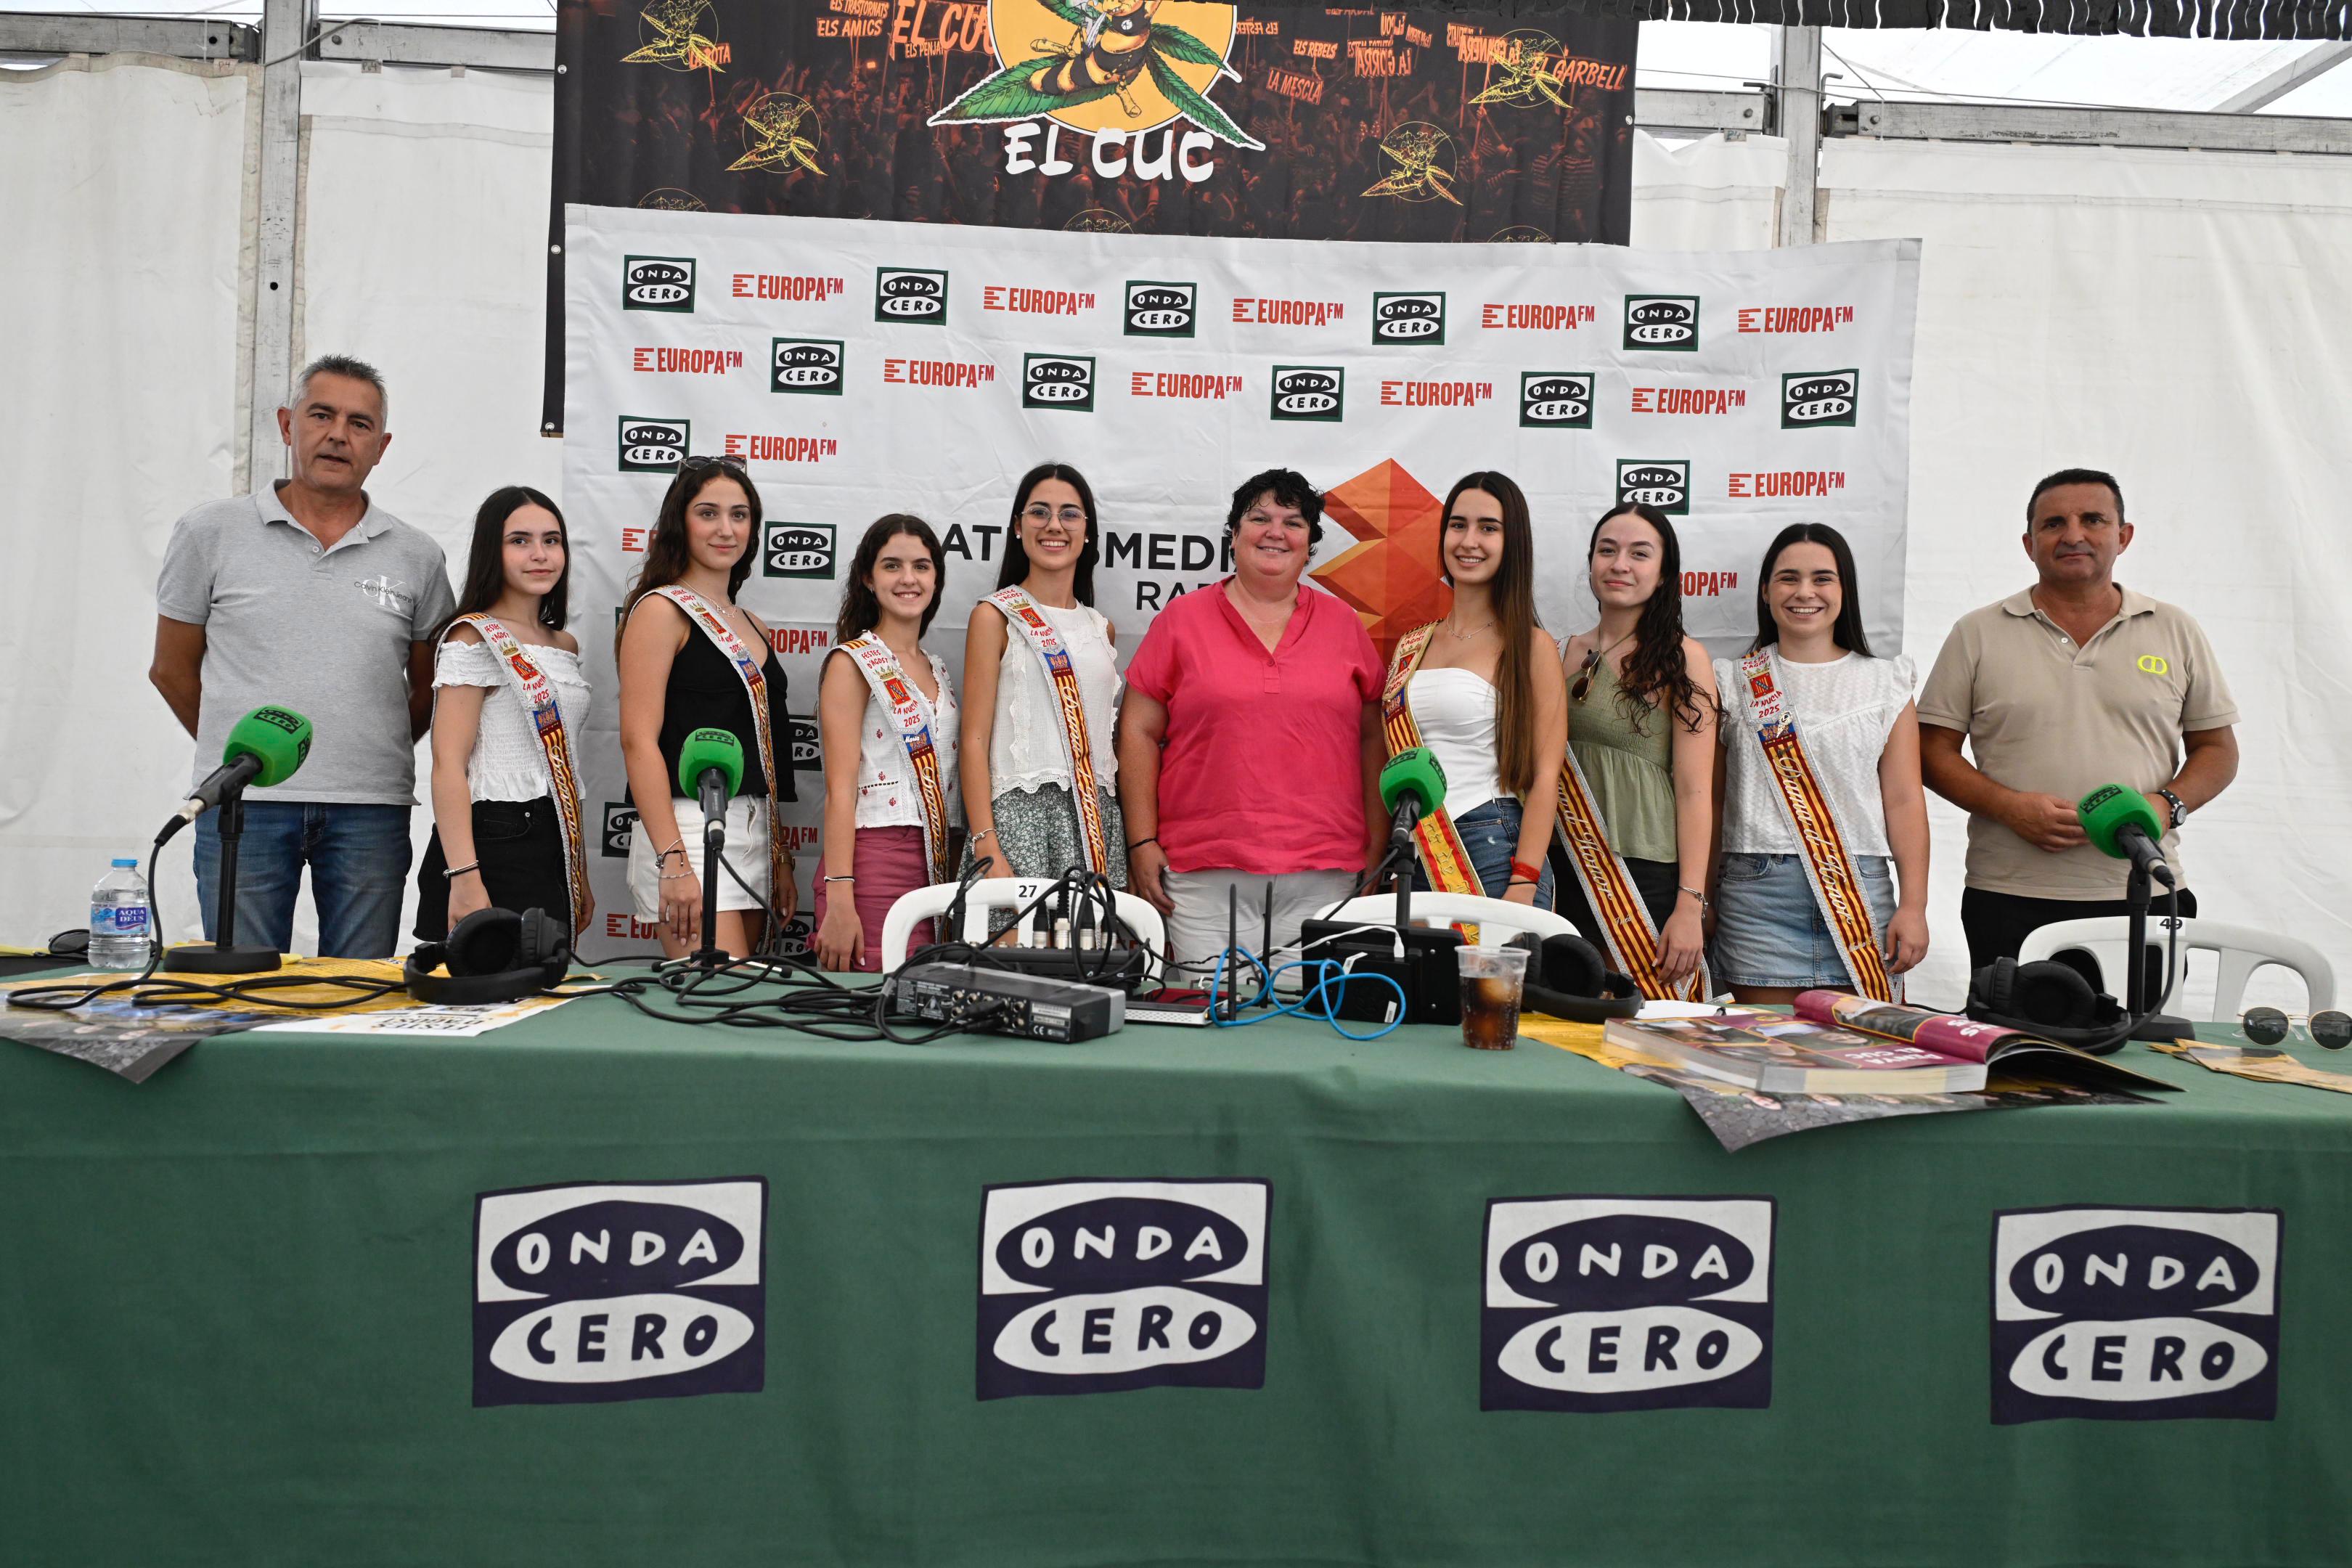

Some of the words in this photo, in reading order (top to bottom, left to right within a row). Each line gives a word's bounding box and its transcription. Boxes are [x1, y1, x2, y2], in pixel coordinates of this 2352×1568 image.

[817, 20, 838, 36] ELS
[841, 19, 883, 36] AMICS
[1294, 39, 1307, 56] ELS
[1307, 41, 1338, 59] REBELS
[1266, 69, 1280, 91] LA
[1280, 75, 1323, 105] MESCLA
[1004, 122, 1074, 177] EL
[1091, 126, 1214, 183] CUC
[636, 269, 682, 280] ONDA
[637, 287, 682, 299] CERO
[888, 281, 935, 293] ONDA
[890, 299, 934, 312] CERO
[1138, 293, 1183, 306] ONDA
[1385, 304, 1432, 316] ONDA
[1637, 309, 1685, 319] ONDA
[1138, 312, 1183, 324] CERO
[1387, 321, 1432, 333] CERO
[1638, 327, 1684, 339] CERO
[784, 351, 830, 362] ONDA
[785, 369, 830, 382] CERO
[1035, 366, 1081, 378] ONDA
[1284, 377, 1330, 389] ONDA
[1794, 382, 1845, 397] ONDA
[1037, 385, 1081, 398] CERO
[1533, 385, 1580, 396] ONDA
[1286, 396, 1330, 409] CERO
[1797, 401, 1845, 417] CERO
[1535, 403, 1580, 416] CERO
[629, 429, 677, 441] ONDA
[632, 447, 676, 461] CERO
[1628, 472, 1675, 483] ONDA
[1630, 490, 1675, 503] CERO
[776, 535, 822, 547] ONDA
[777, 553, 822, 566] CERO
[1041, 638, 1057, 648] 2025
[861, 649, 881, 660] FESTES
[867, 658, 888, 669] D'AGOST
[533, 688, 550, 704] 2025
[1749, 699, 1759, 708] LA
[1760, 690, 1783, 707] NUCIA
[903, 699, 919, 715] NUCIA
[1758, 703, 1780, 719] 2025
[903, 714, 920, 727] 2025
[795, 729, 814, 738] DA
[794, 746, 814, 758] RO
[1773, 756, 1813, 828] Dama
[1018, 884, 1037, 898] 27
[517, 1229, 718, 1275] ONDA
[1021, 1225, 1222, 1269] ONDA
[1524, 1241, 1729, 1283] ONDA
[2033, 1253, 2237, 1294] ONDA
[1031, 1304, 1222, 1357] CERO
[527, 1313, 718, 1365] CERO
[1535, 1325, 1729, 1374] CERO
[2042, 1334, 2235, 1382] CERO
